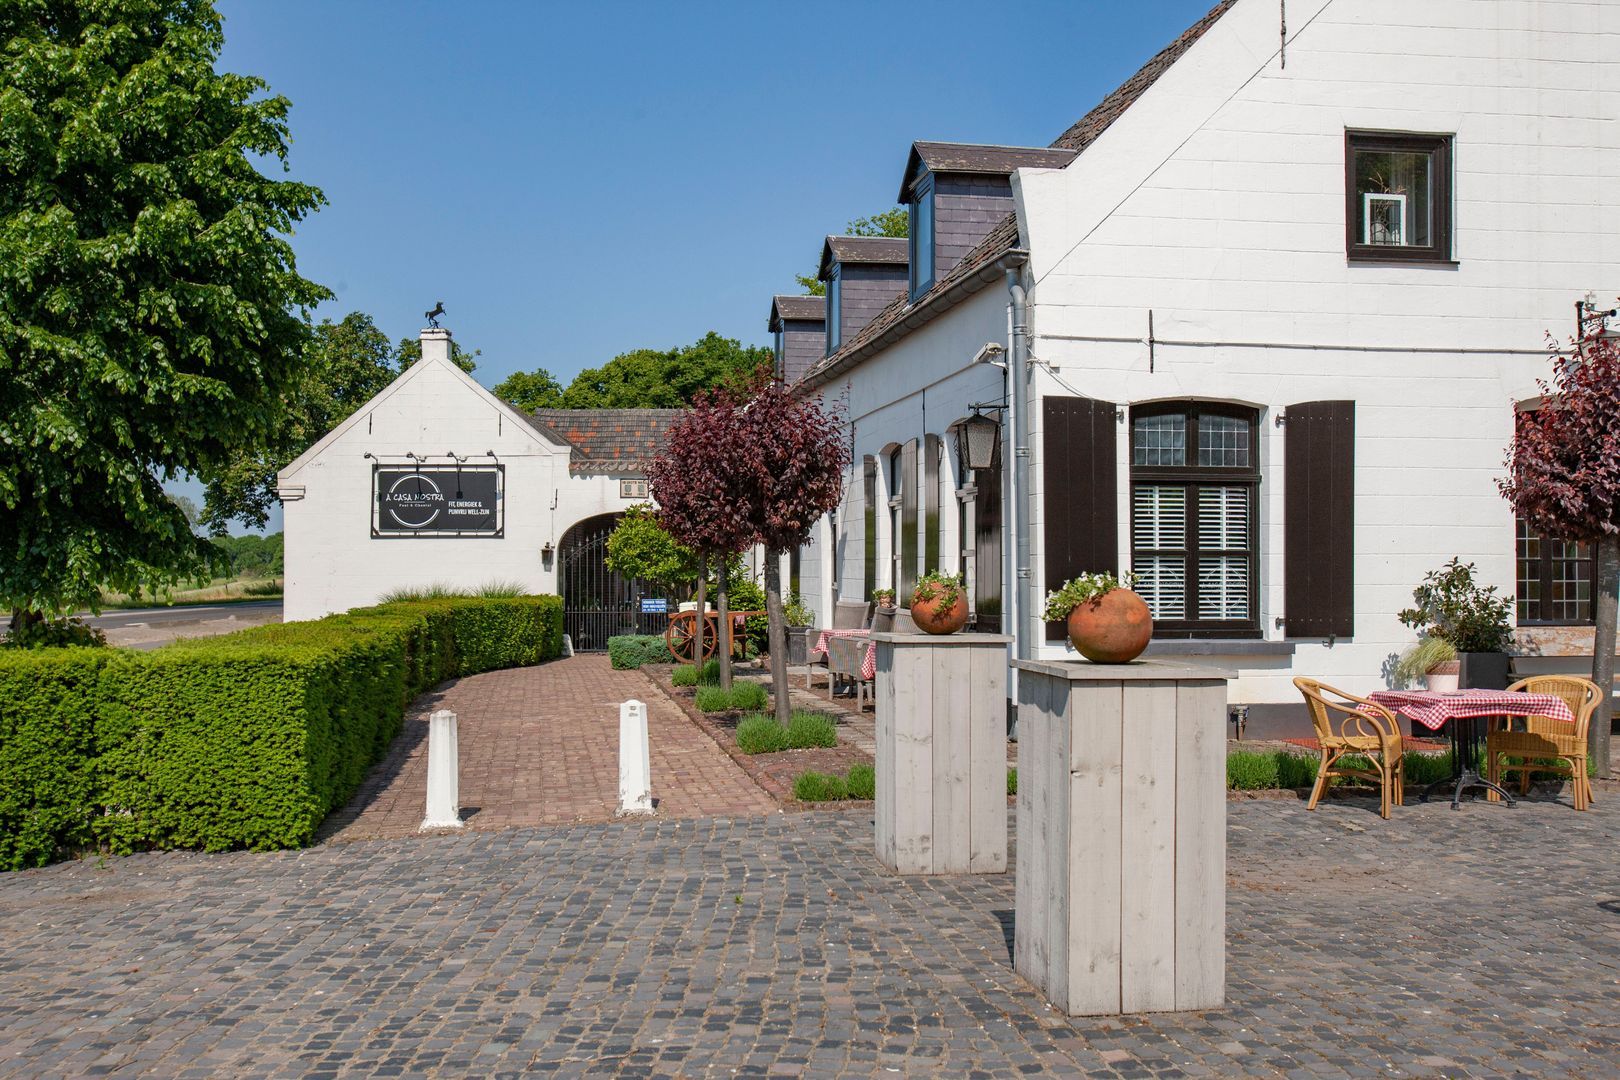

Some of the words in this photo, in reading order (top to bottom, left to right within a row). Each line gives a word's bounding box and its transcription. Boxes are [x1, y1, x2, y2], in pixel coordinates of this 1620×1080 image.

[386, 494, 391, 502] A
[393, 494, 412, 502] CASA
[414, 494, 444, 502] NOSTRA
